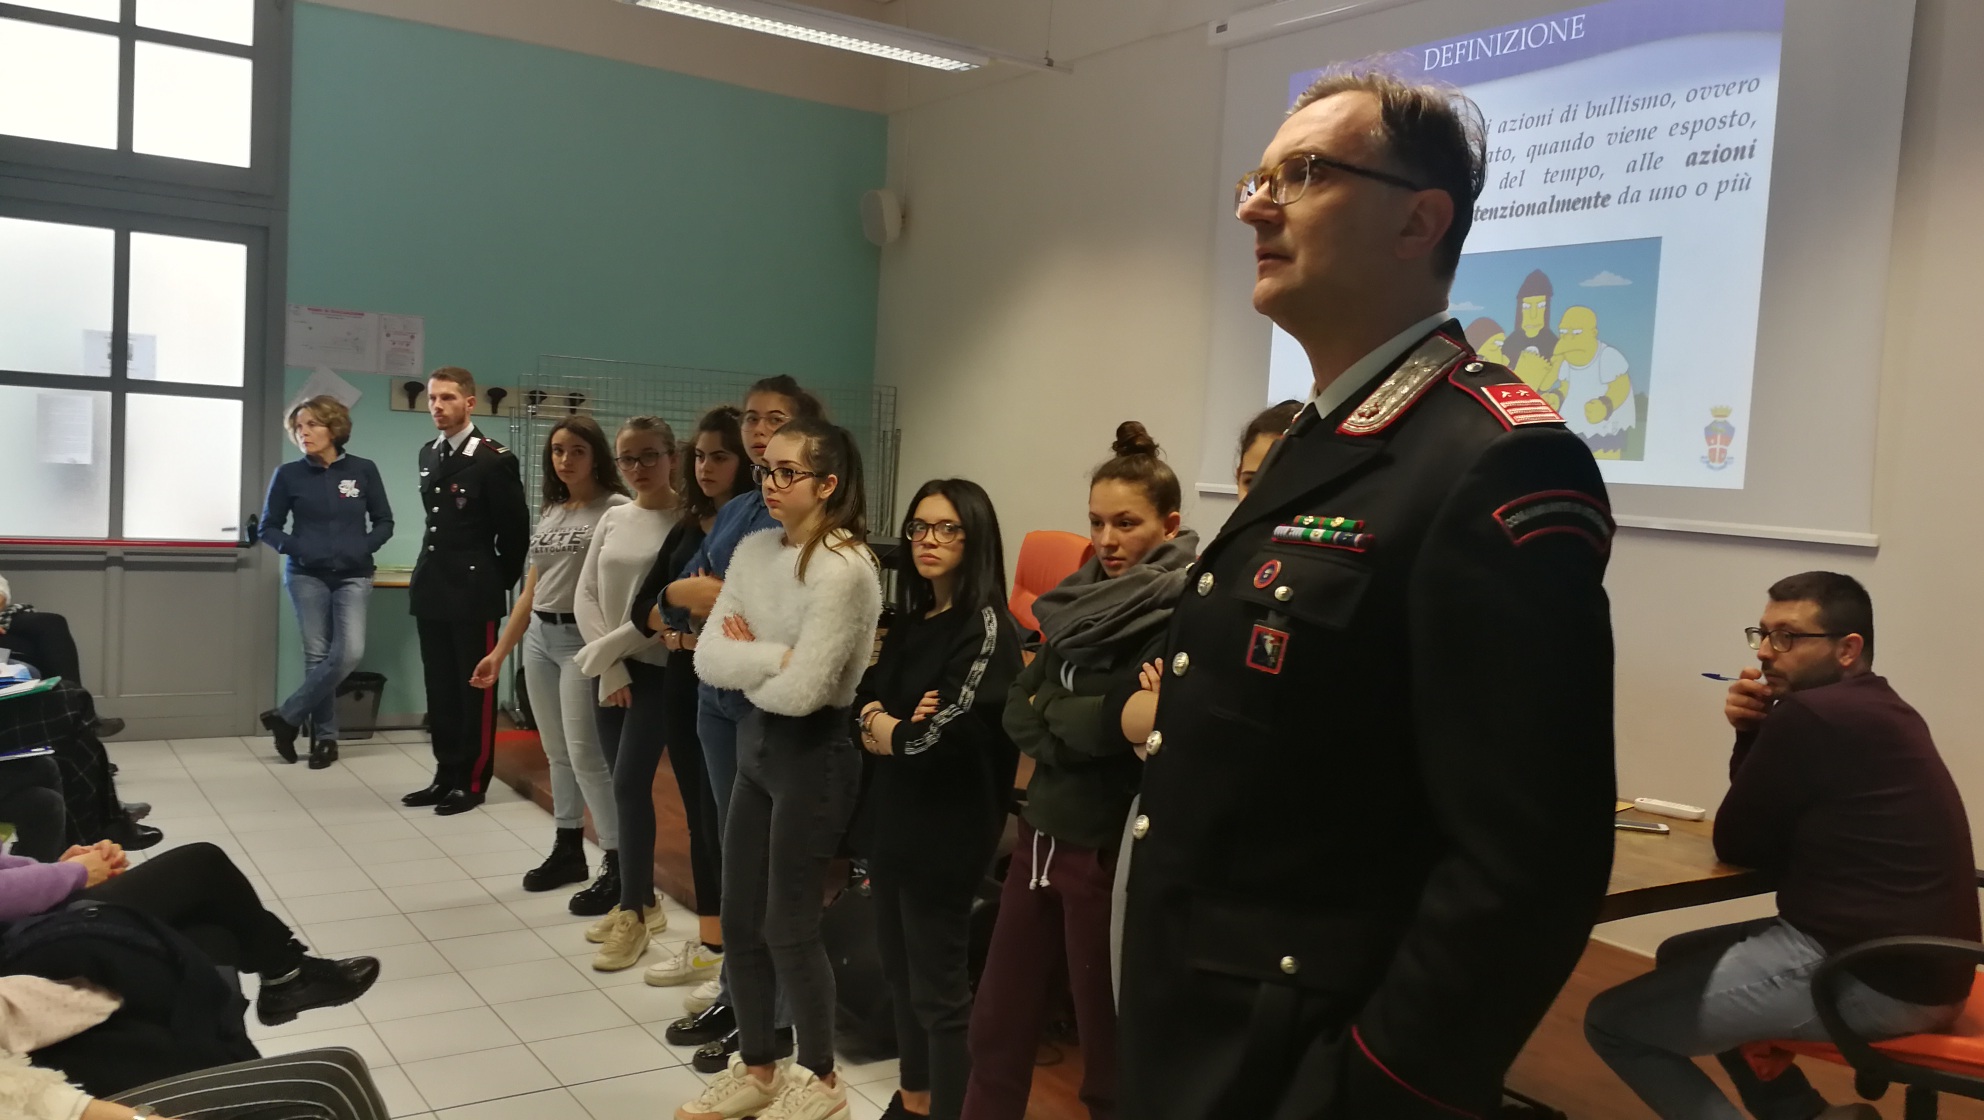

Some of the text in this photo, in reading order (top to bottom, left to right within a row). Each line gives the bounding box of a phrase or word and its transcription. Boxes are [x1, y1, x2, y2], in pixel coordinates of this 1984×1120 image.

[1423, 14, 1586, 71] DEFINIZIONE
[1497, 108, 1554, 134] azioni
[1559, 103, 1579, 124] di
[1585, 92, 1677, 120] bullismo,
[1685, 77, 1761, 103] ovvero
[1486, 109, 1757, 164] ato, quando viene esposto,
[1499, 138, 1758, 190] del tempo, alle azioni
[1473, 172, 1752, 222] tenzionalmente da uno o più
